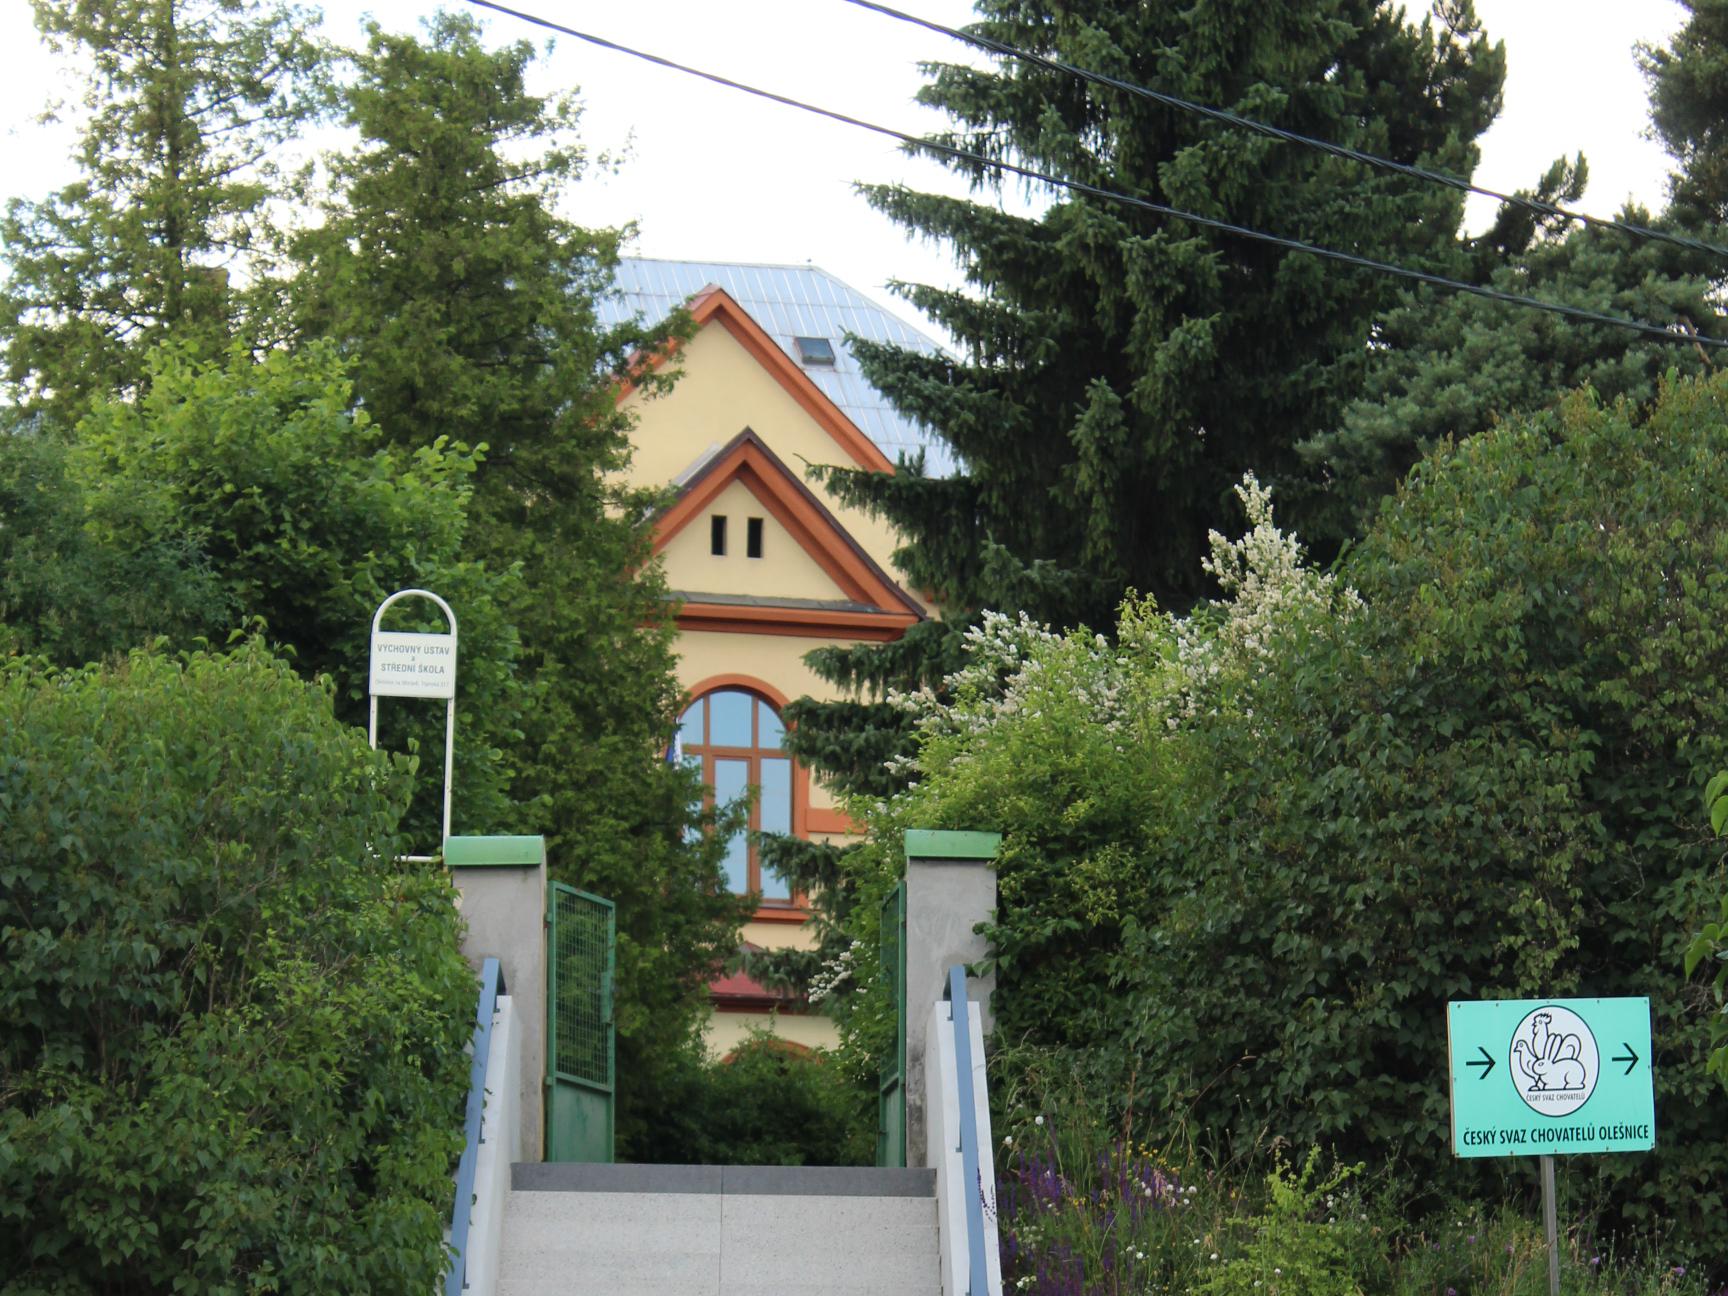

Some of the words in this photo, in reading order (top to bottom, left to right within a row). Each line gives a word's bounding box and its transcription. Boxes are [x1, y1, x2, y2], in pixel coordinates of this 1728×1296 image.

[418, 663, 445, 674] ŠKOLA
[1542, 1093, 1555, 1101] SVAZ
[1556, 1092, 1585, 1101] CHOVATELŮ
[1463, 1126, 1496, 1146] ČESKÝ
[1499, 1128, 1527, 1144] SVAZ
[1530, 1122, 1595, 1143] CHOVATELŮ
[1598, 1121, 1649, 1141] OLEŠNICE
